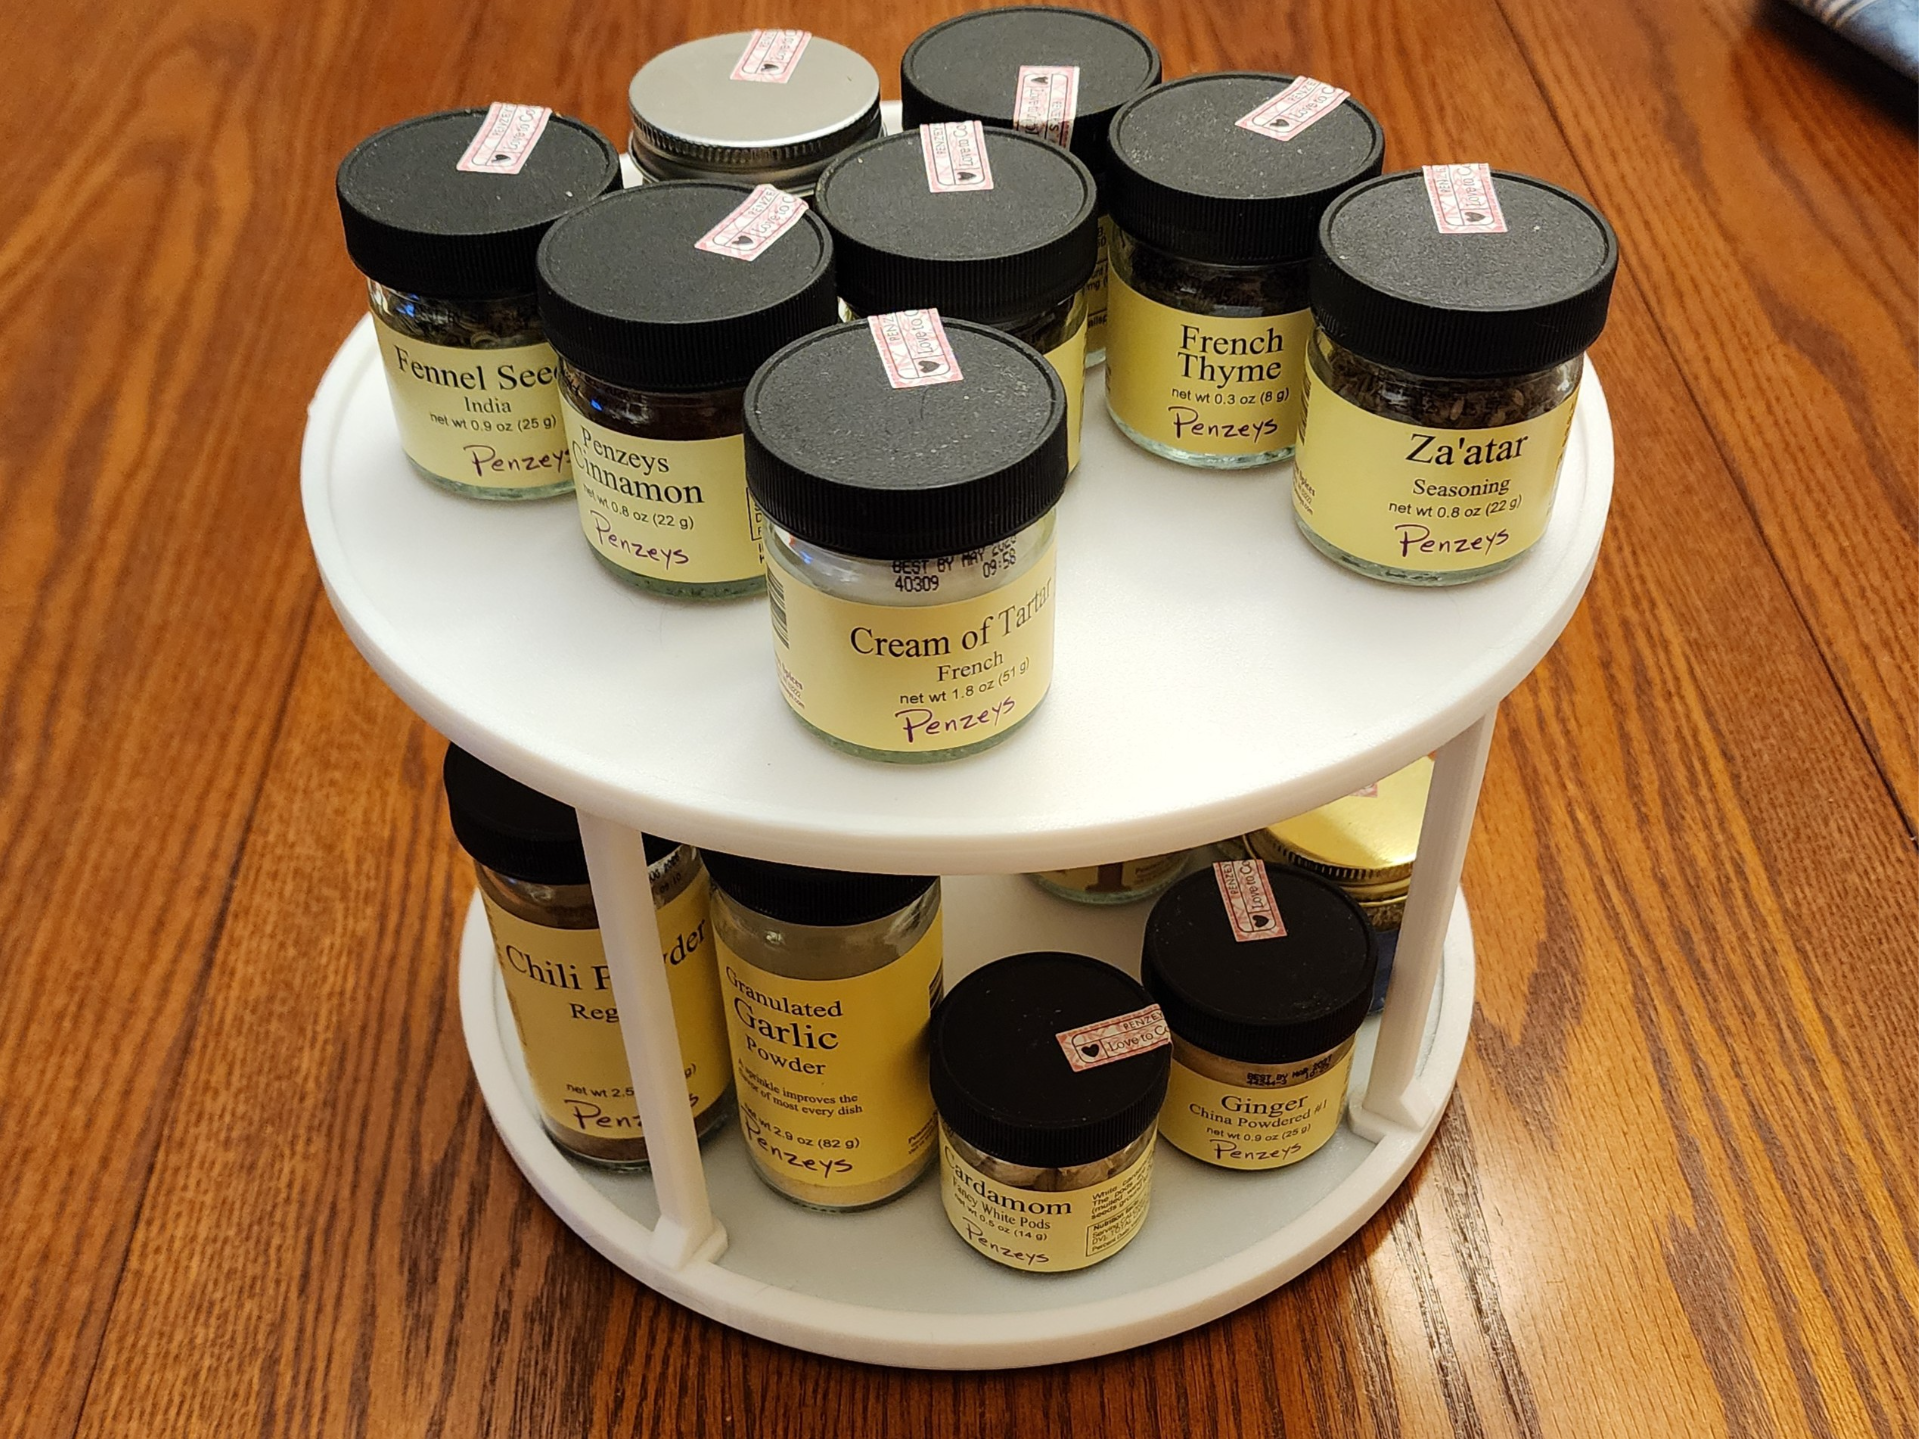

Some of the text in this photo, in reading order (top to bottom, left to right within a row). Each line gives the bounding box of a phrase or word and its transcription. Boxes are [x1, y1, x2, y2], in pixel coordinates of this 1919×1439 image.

[1180, 323, 1284, 356] French
[394, 345, 487, 391] Fennel
[1177, 352, 1282, 390] Thyme
[464, 396, 512, 414] India
[1171, 387, 1290, 405] net wt 0.3 oz (8 g)
[430, 411, 557, 433] net wt 0.9 oz (25 g)
[1167, 405, 1279, 444] Penzeys
[581, 424, 670, 476] Penzeys
[1405, 432, 1530, 467] Za'atar
[572, 440, 705, 504] Cinnamon
[1412, 477, 1512, 499] Seasoning
[583, 483, 694, 531] net wt 0.8 oz (22 g)
[1388, 494, 1523, 519] net wt 0.8 oz (22 g)
[590, 509, 690, 571] Penzeys
[1394, 523, 1510, 558] Penzeys
[892, 559, 930, 575] BEST
[937, 556, 954, 573] BY
[895, 574, 940, 593] 40309
[850, 577, 1053, 658] Cream of Tartar
[900, 656, 1031, 705] net wt 1.8 oz (51 g)
[937, 651, 1004, 682] French
[894, 695, 1016, 744] Penzeys
[1245, 875, 1257, 886] to
[1249, 885, 1265, 910] Love
[505, 919, 706, 992] Chili Pder
[726, 966, 844, 1018] Granulated
[734, 996, 840, 1051] Garlic
[745, 1033, 827, 1075] Powder
[1107, 1035, 1139, 1052] Love
[1141, 1031, 1154, 1044] to
[566, 1083, 588, 1097] net
[592, 1087, 608, 1099] wt
[611, 1085, 636, 1099] 2.5
[760, 1089, 772, 1100] of
[773, 1098, 799, 1112] most
[801, 1107, 835, 1118] every
[837, 1103, 863, 1116] dish
[782, 1087, 837, 1105] improves
[839, 1094, 859, 1104] the
[1221, 1095, 1308, 1118] Ginger
[1189, 1099, 1327, 1129] China Powdered #1
[741, 1105, 853, 1178] Penzeys
[773, 1125, 794, 1142] 2.9
[797, 1136, 814, 1147] oz
[817, 1138, 841, 1150] (82
[844, 1137, 861, 1150] g)
[1206, 1123, 1311, 1142] net wt 0.9 oz (25 g)
[1209, 1138, 1302, 1160] Penzeys
[944, 1145, 1072, 1215] Cardamom
[952, 1176, 1051, 1230] Fancy White Pods
[979, 1213, 995, 1228] 0.5
[997, 1224, 1010, 1235] oz
[1014, 1228, 1032, 1241] (14
[1036, 1231, 1048, 1242] g)
[1093, 1211, 1124, 1231] Nutrition
[962, 1216, 1050, 1266] Penzeys
